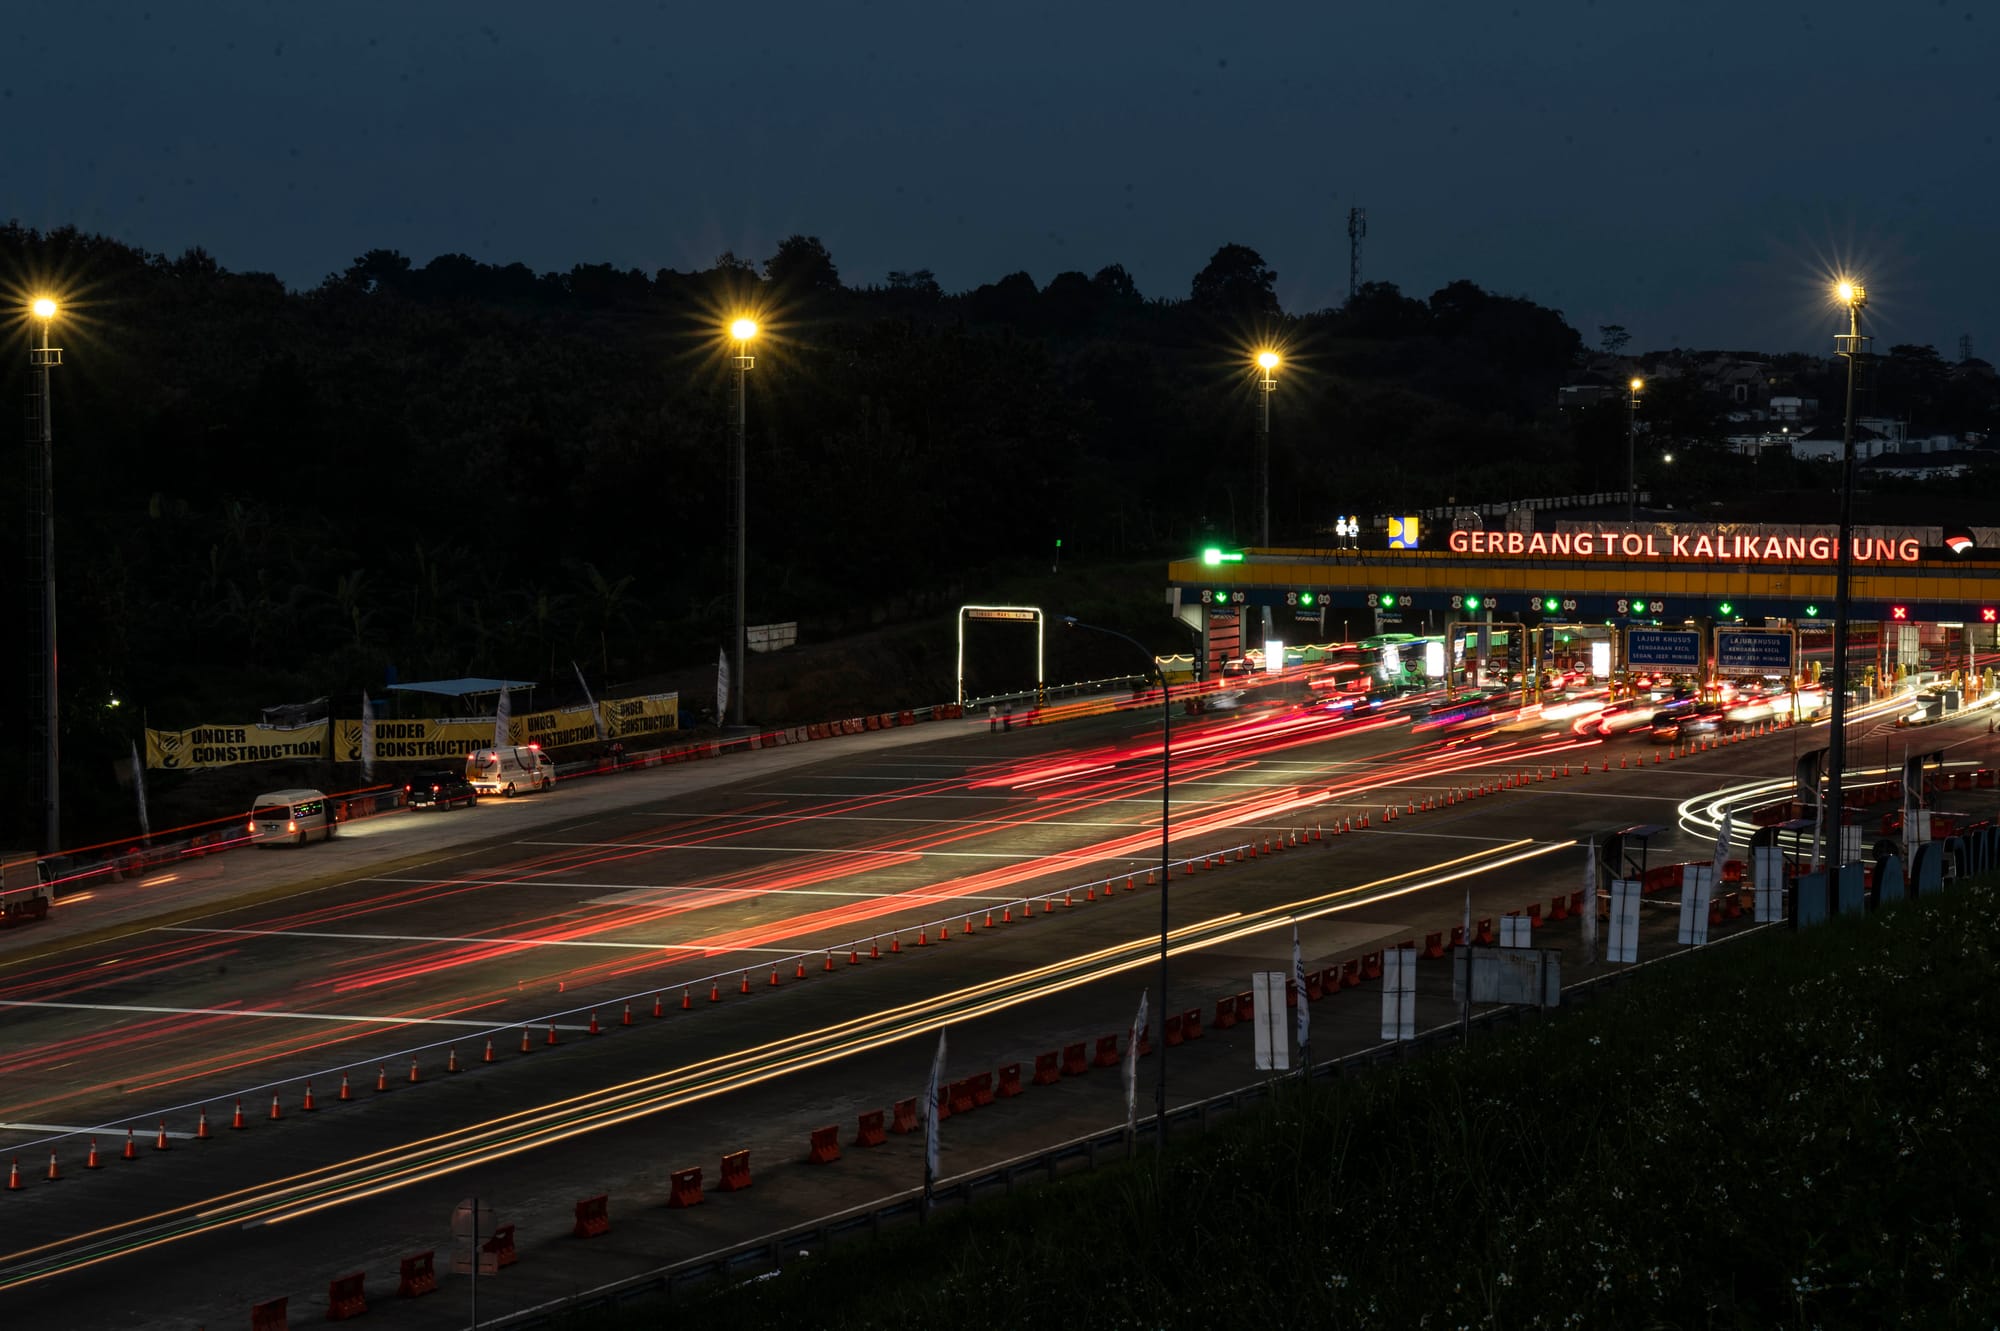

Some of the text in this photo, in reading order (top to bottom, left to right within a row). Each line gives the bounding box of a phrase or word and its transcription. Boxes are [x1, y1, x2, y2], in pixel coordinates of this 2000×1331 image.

[1449, 530, 1593, 555] GERBANG
[1601, 533, 1660, 557] TOL
[1637, 635, 1691, 644] LAJUR KHUSUS
[620, 701, 643, 715] UNDER
[376, 724, 425, 739] UNDER
[528, 715, 556, 732] UNDER
[621, 714, 675, 734] CONSTRUCTION
[191, 729, 246, 744] UNDER
[528, 725, 595, 747] CONSTRUCTION
[192, 741, 321, 763] CONSTRUCTION
[376, 739, 492, 757] CONSTRUCTION
